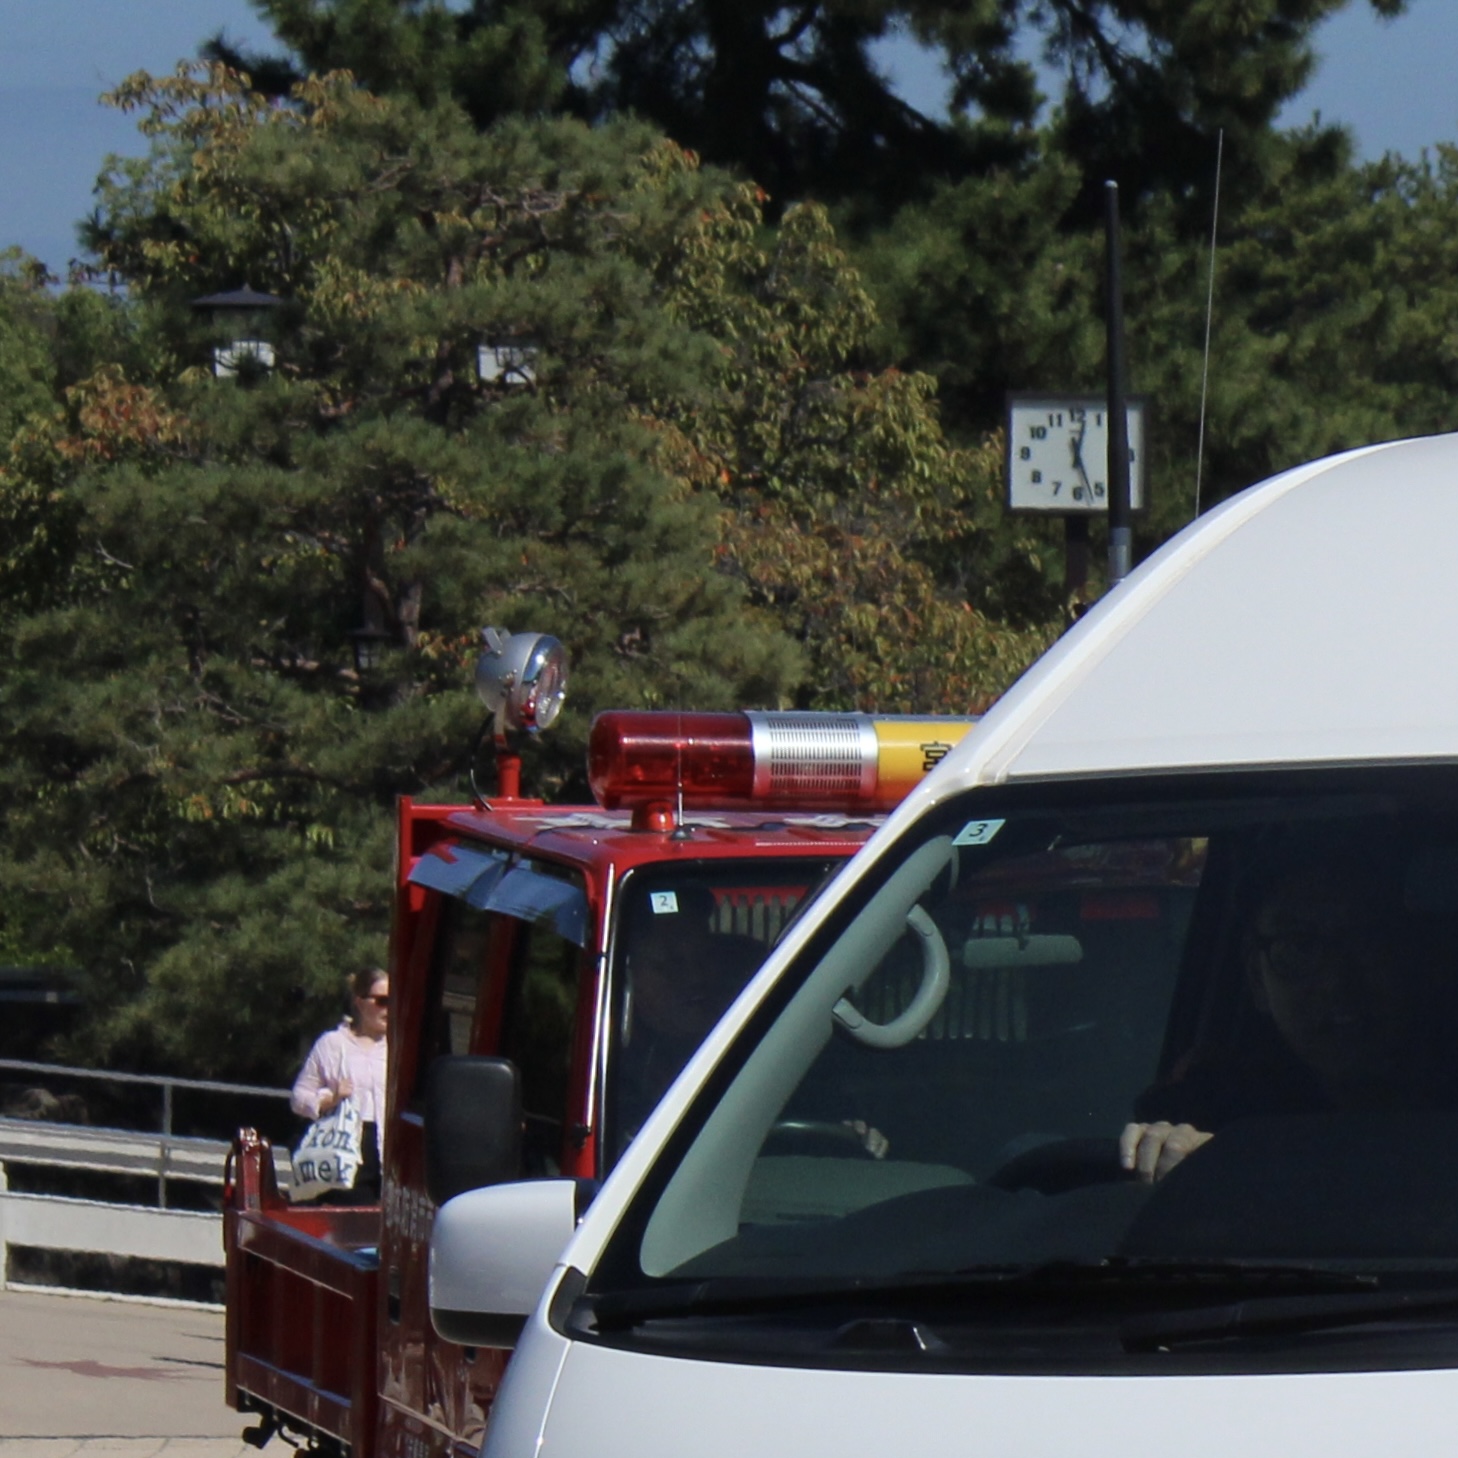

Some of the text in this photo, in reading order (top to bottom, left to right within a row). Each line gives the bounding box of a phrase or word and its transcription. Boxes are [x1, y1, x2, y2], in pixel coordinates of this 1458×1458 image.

[1048, 414, 1062, 427] 11
[1096, 414, 1102, 427] 1
[1030, 426, 1046, 440] 10
[1052, 482, 1062, 496] 7
[1094, 482, 1104, 497] 5
[969, 823, 988, 838] 3
[659, 895, 669, 907] 2
